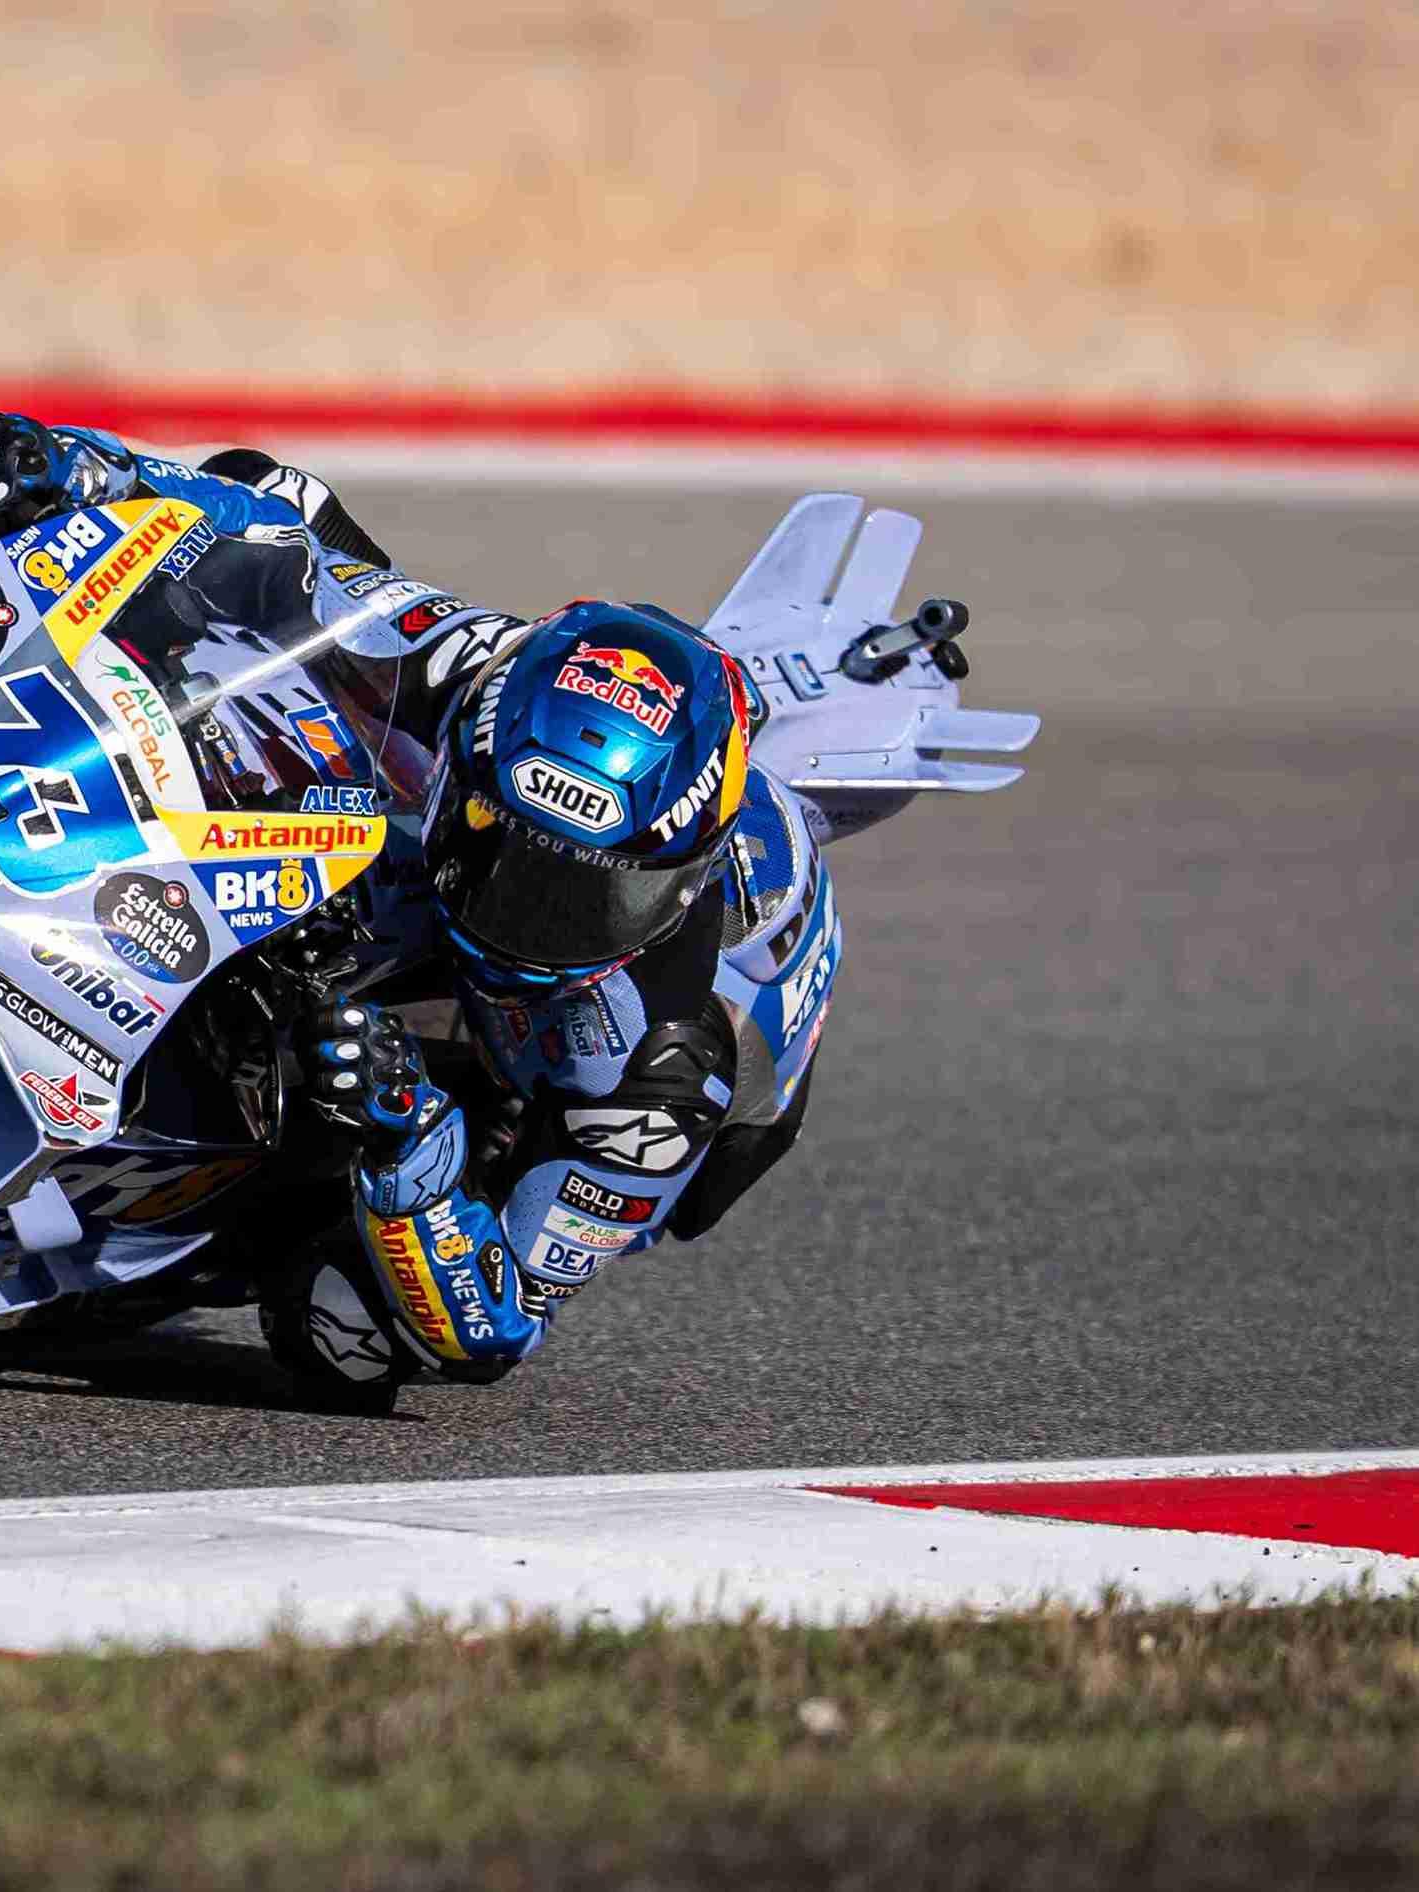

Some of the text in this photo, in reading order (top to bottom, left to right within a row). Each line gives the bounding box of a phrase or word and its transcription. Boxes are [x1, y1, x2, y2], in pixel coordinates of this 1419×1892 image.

[6, 525, 42, 560] NEWS
[17, 511, 106, 592] BK8
[65, 507, 182, 626] Antangin
[158, 518, 219, 582] ALEX
[130, 688, 173, 738] AUS
[554, 664, 674, 737] Red Bull
[112, 691, 173, 793] GLOBAL
[300, 786, 375, 814] ALEX
[525, 766, 610, 824] SHOEI
[200, 819, 367, 853] Antangin
[525, 827, 566, 854] YOU
[574, 847, 642, 873] WINGS
[120, 883, 197, 952] Estrella
[215, 861, 314, 915] BK8
[112, 904, 181, 968] Galicia
[230, 911, 273, 928] NEWS
[24, 1074, 99, 1130] FEDERAL OIL
[566, 1175, 623, 1210] BOLD
[425, 1200, 474, 1265] BK8
[378, 1220, 446, 1344] Antangin
[448, 1268, 494, 1340] NEWS
